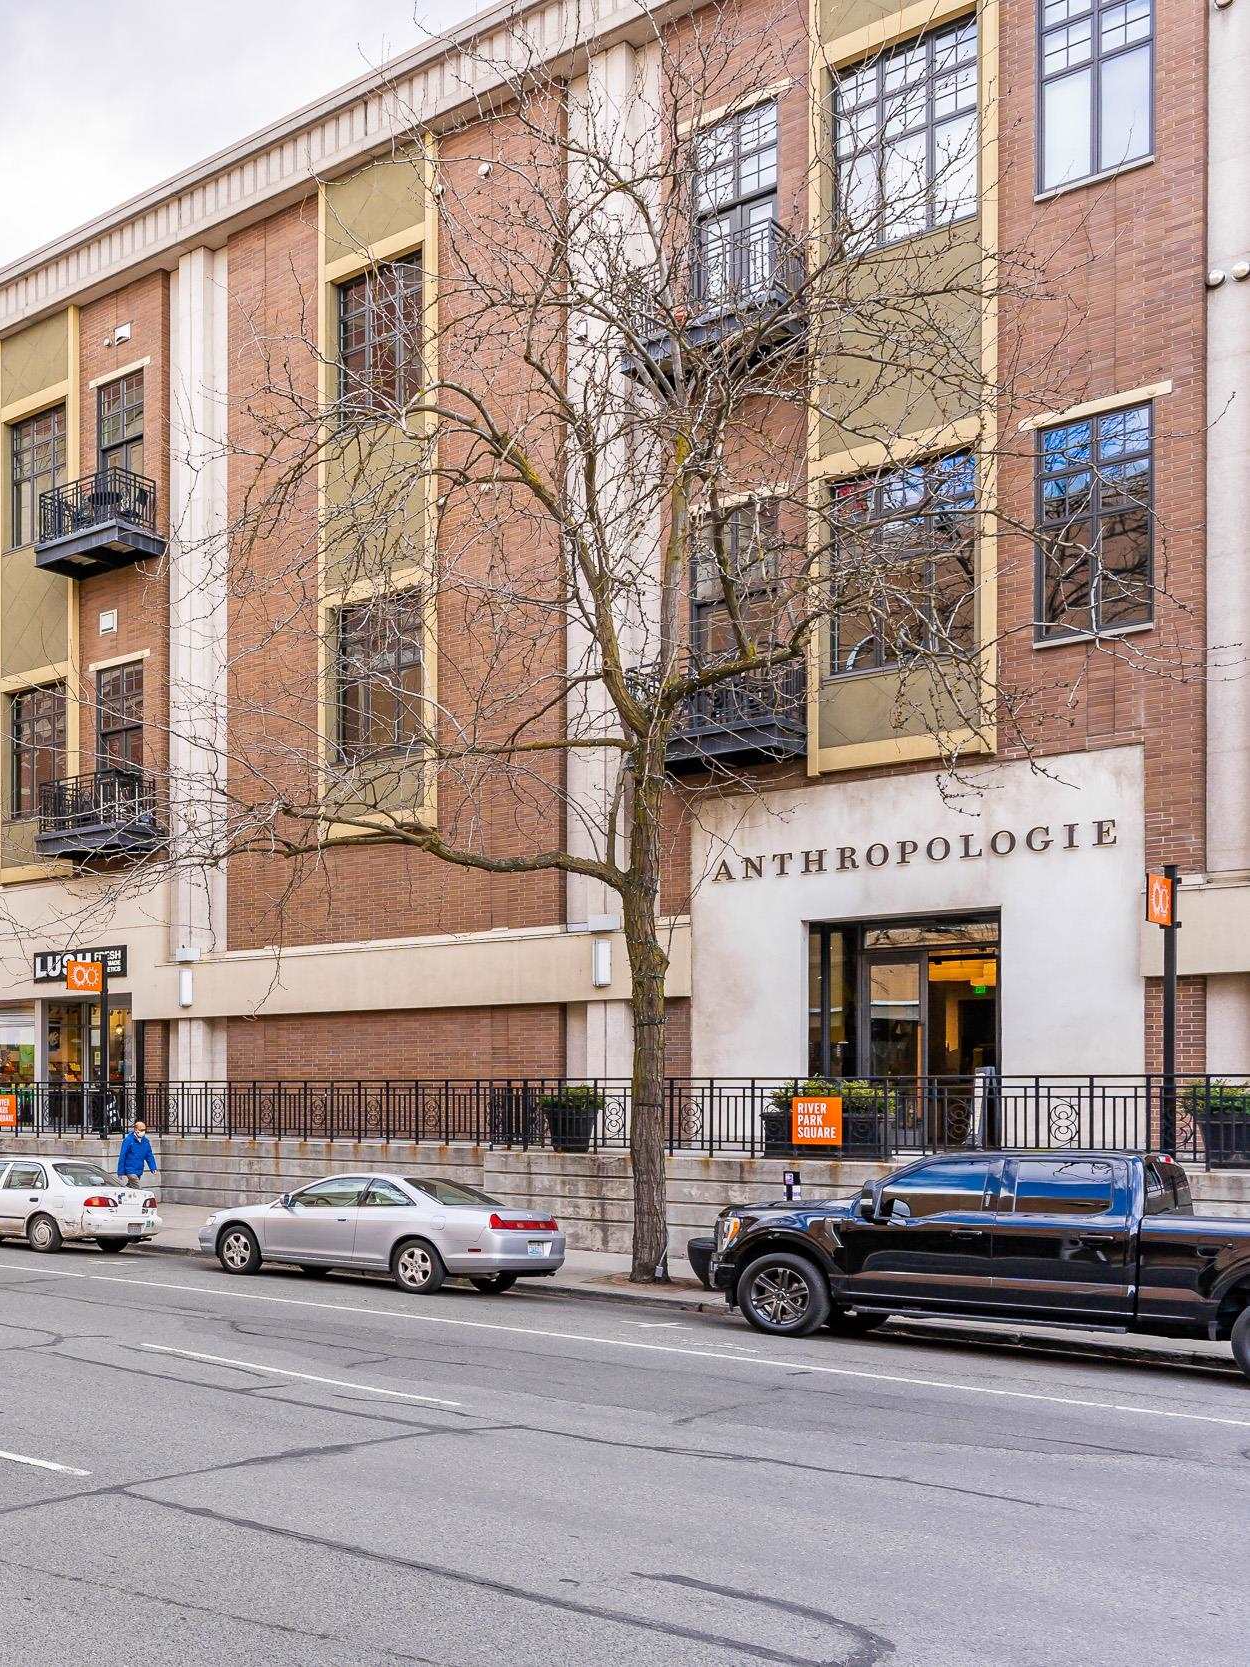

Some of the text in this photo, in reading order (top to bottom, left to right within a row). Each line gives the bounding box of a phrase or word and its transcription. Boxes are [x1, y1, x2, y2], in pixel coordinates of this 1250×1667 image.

[712, 819, 1117, 882] ANTHROPOLOGIE
[798, 1102, 827, 1114] RIVER
[797, 1114, 823, 1126] PARK
[797, 1126, 837, 1139] SQUARE
